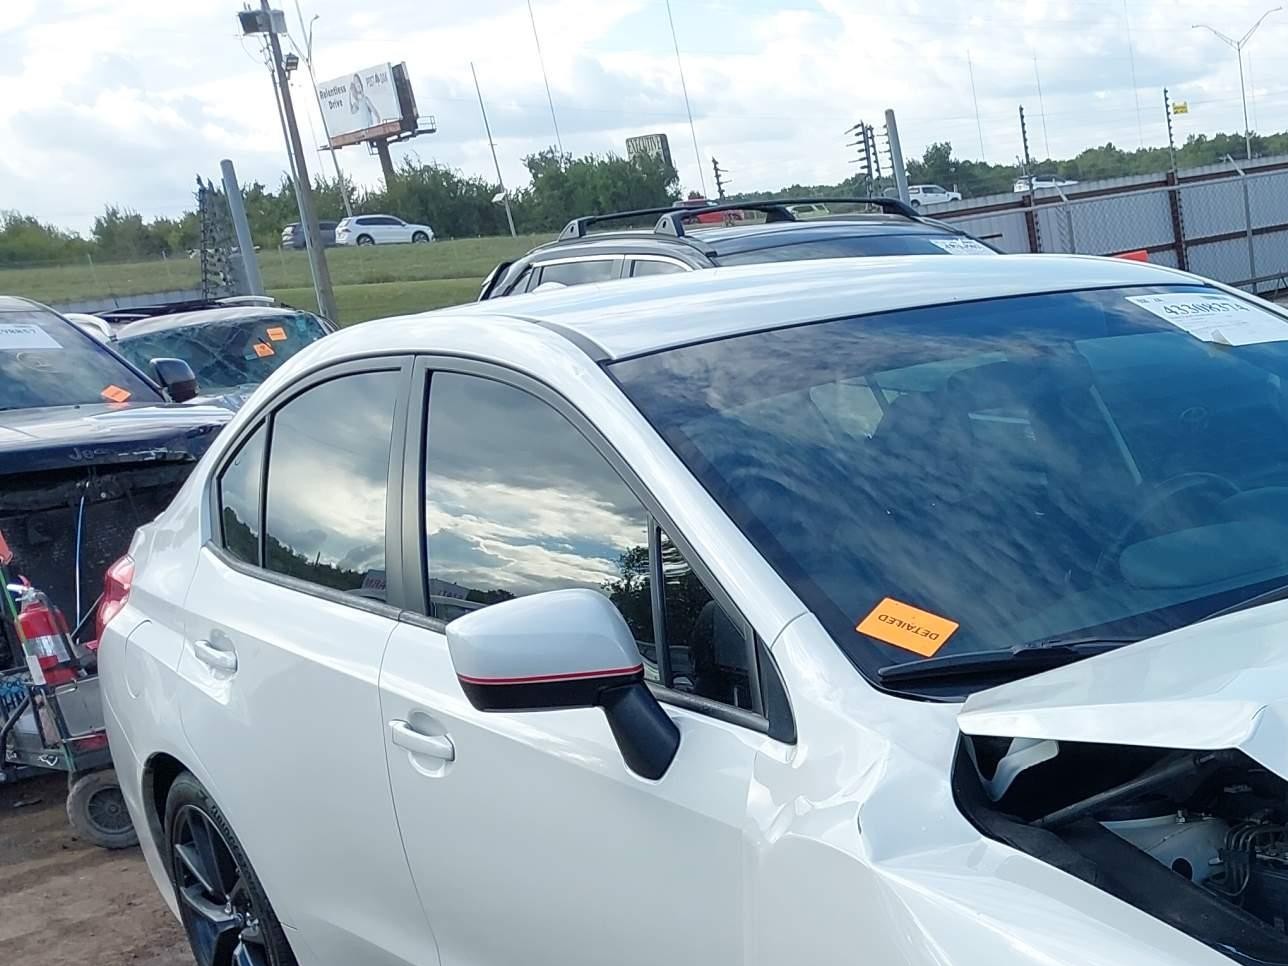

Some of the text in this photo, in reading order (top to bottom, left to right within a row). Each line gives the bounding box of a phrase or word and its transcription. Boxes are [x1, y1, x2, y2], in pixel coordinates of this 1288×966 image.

[319, 85, 347, 99] Relentless
[328, 100, 343, 110] Drive
[1163, 303, 1250, 315] 43308374
[878, 614, 940, 641] DETAILED
